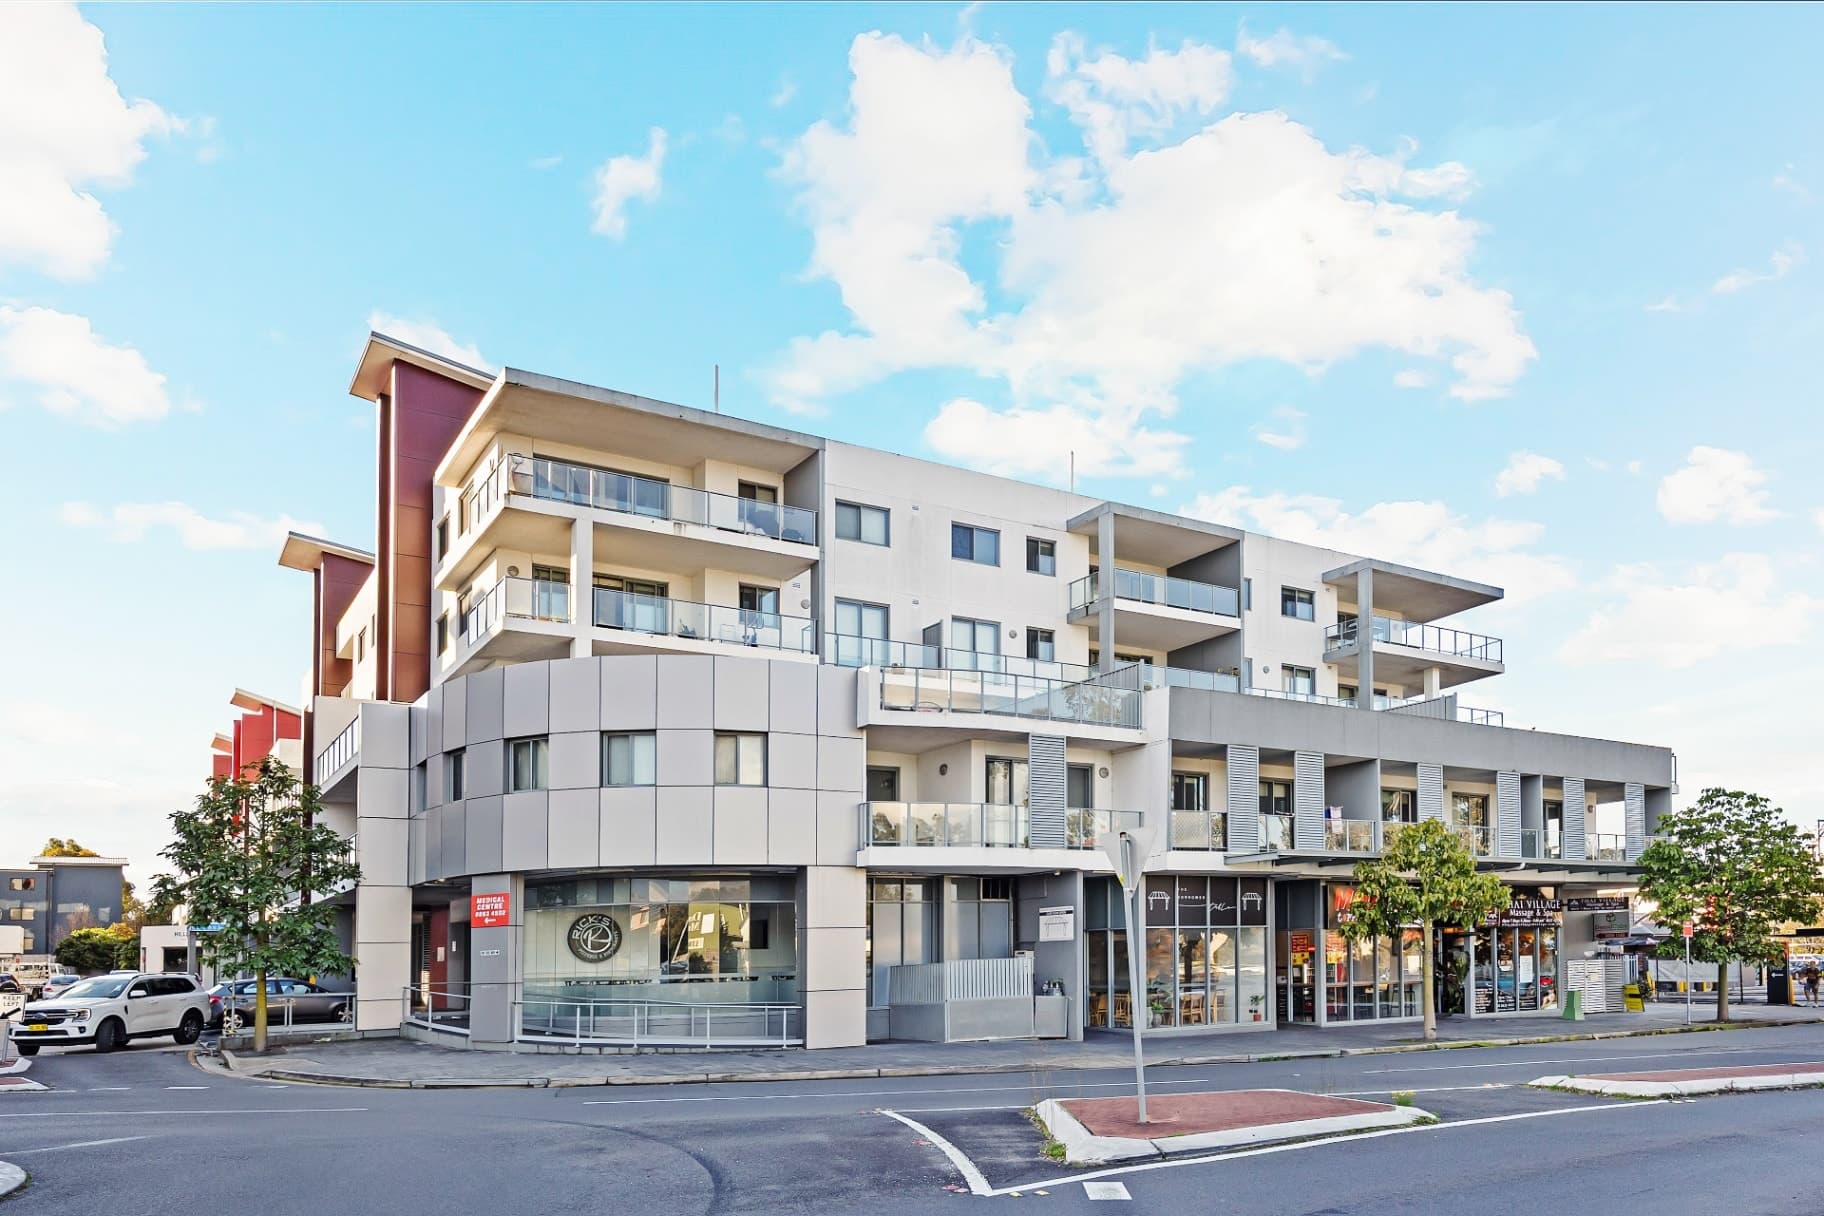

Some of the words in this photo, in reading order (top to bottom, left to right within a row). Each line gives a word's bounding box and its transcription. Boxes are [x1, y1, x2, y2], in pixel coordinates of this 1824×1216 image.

[476, 896, 505, 904] MEDICAL
[1526, 900, 1561, 909] VILLAGE
[476, 903, 503, 911] CENTRE
[1509, 908, 1534, 918] Massage
[1536, 908, 1541, 917] &
[1543, 908, 1553, 918] Spa
[572, 915, 611, 940] RICK'S
